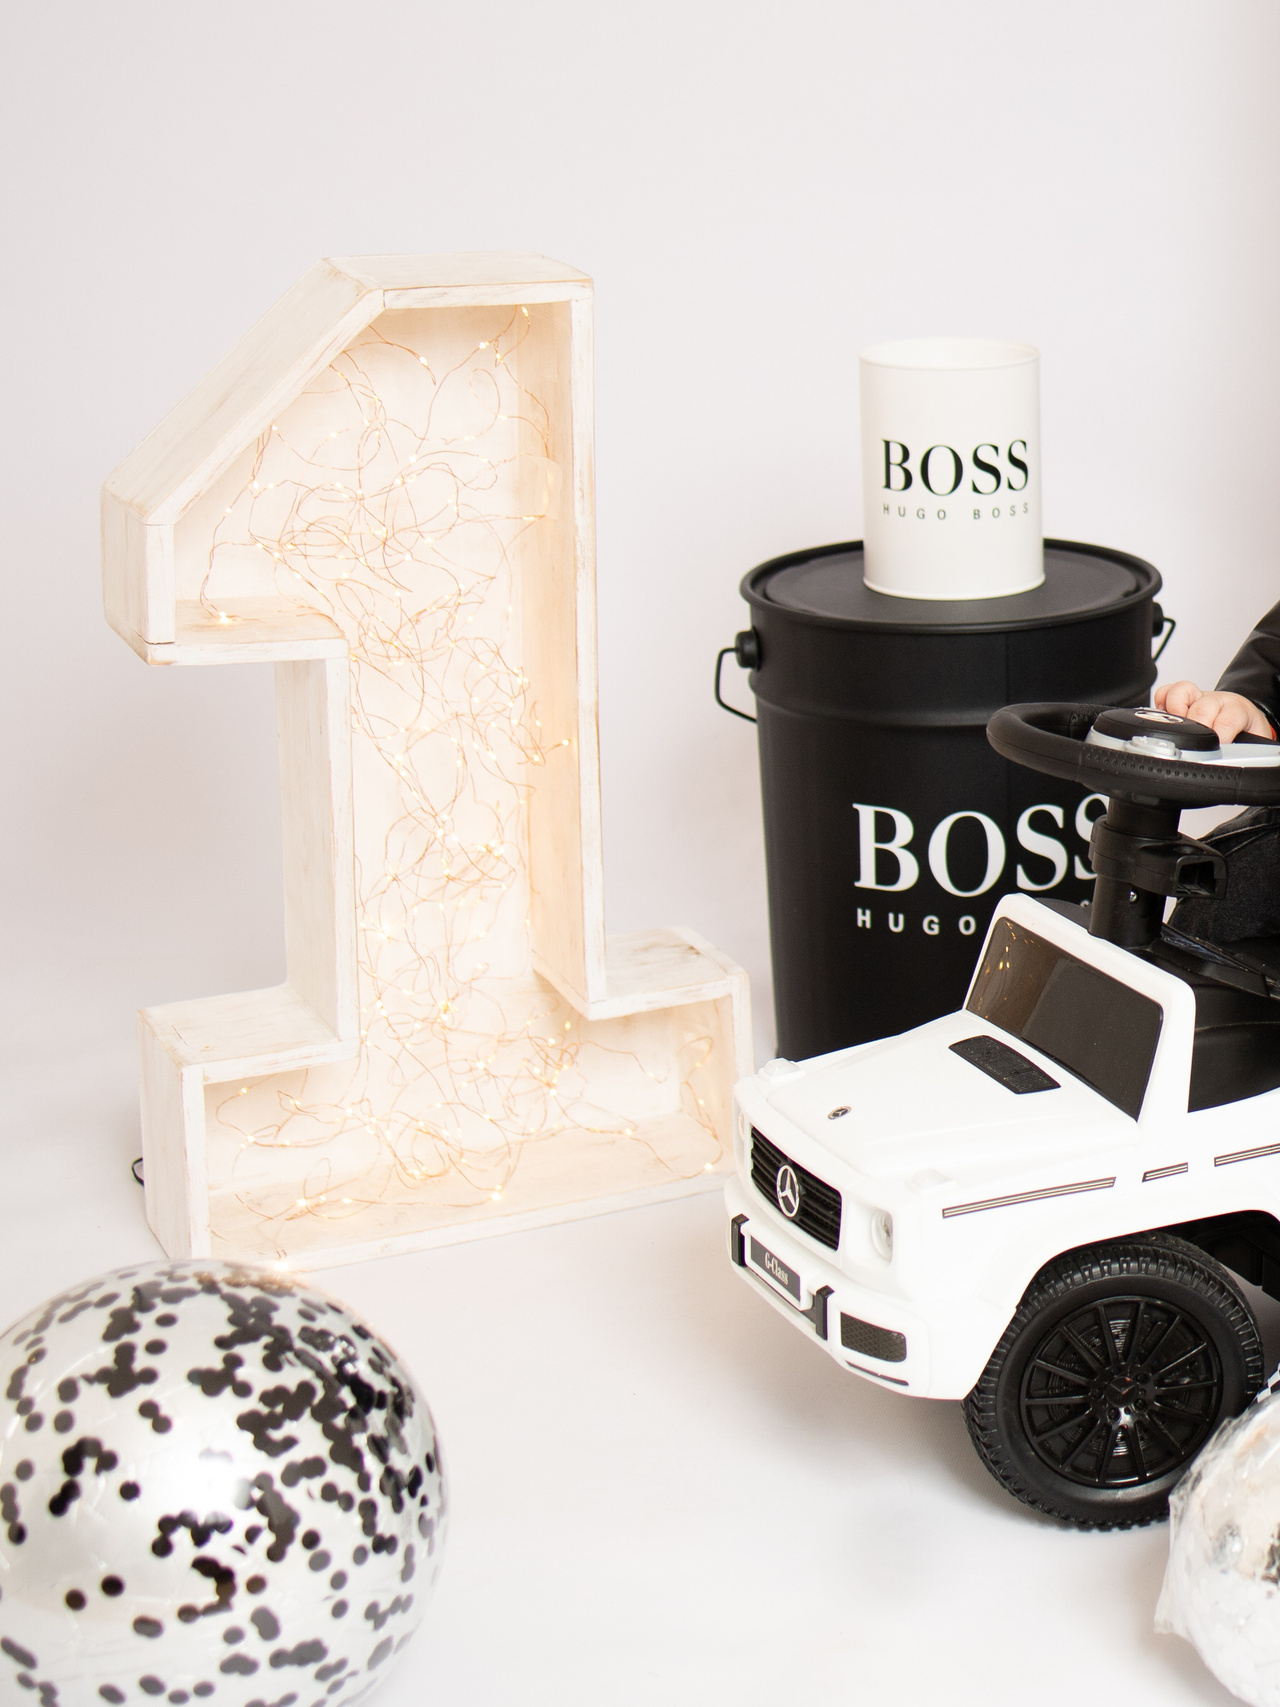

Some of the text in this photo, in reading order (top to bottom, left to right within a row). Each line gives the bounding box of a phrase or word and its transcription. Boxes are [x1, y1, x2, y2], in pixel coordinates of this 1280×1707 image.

[881, 438, 1030, 497] BOSS
[882, 502, 1029, 521] HUGO BOSS
[856, 908, 976, 936] HUGO
[764, 1251, 789, 1286] G-Class
